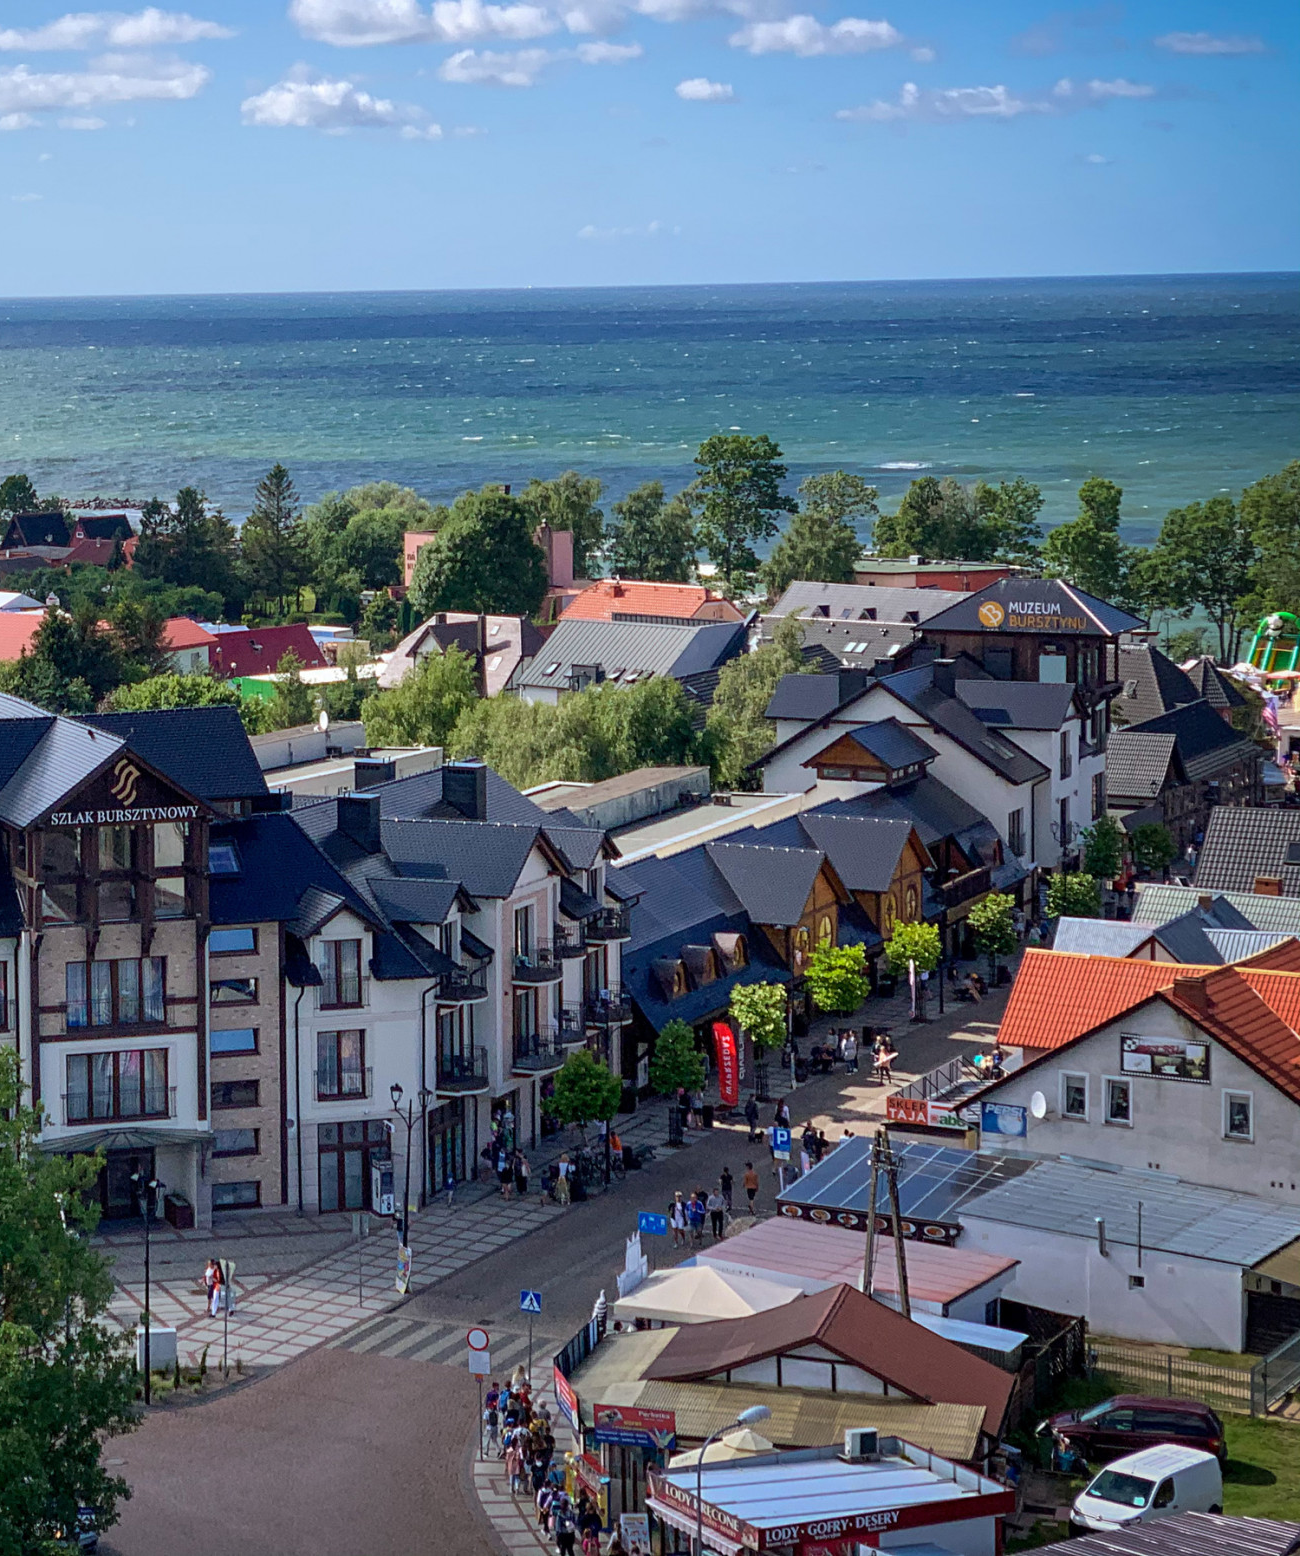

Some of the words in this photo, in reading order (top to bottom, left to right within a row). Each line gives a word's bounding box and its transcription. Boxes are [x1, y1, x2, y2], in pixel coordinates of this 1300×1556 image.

[1008, 601, 1061, 615] MUZEUM
[1009, 615, 1087, 630] BURSZTYNU
[51, 810, 94, 826] SZLAK
[97, 805, 199, 824] BURSZTYNOWY
[889, 1098, 927, 1112] SKLEP
[985, 1103, 1024, 1118] PEPSI
[889, 1108, 927, 1123] TAJA
[777, 1130, 788, 1145] P
[665, 1483, 692, 1505] LODY
[766, 1526, 800, 1543] LODY
[807, 1519, 849, 1536] GOFRY
[855, 1511, 900, 1529] DESERY
